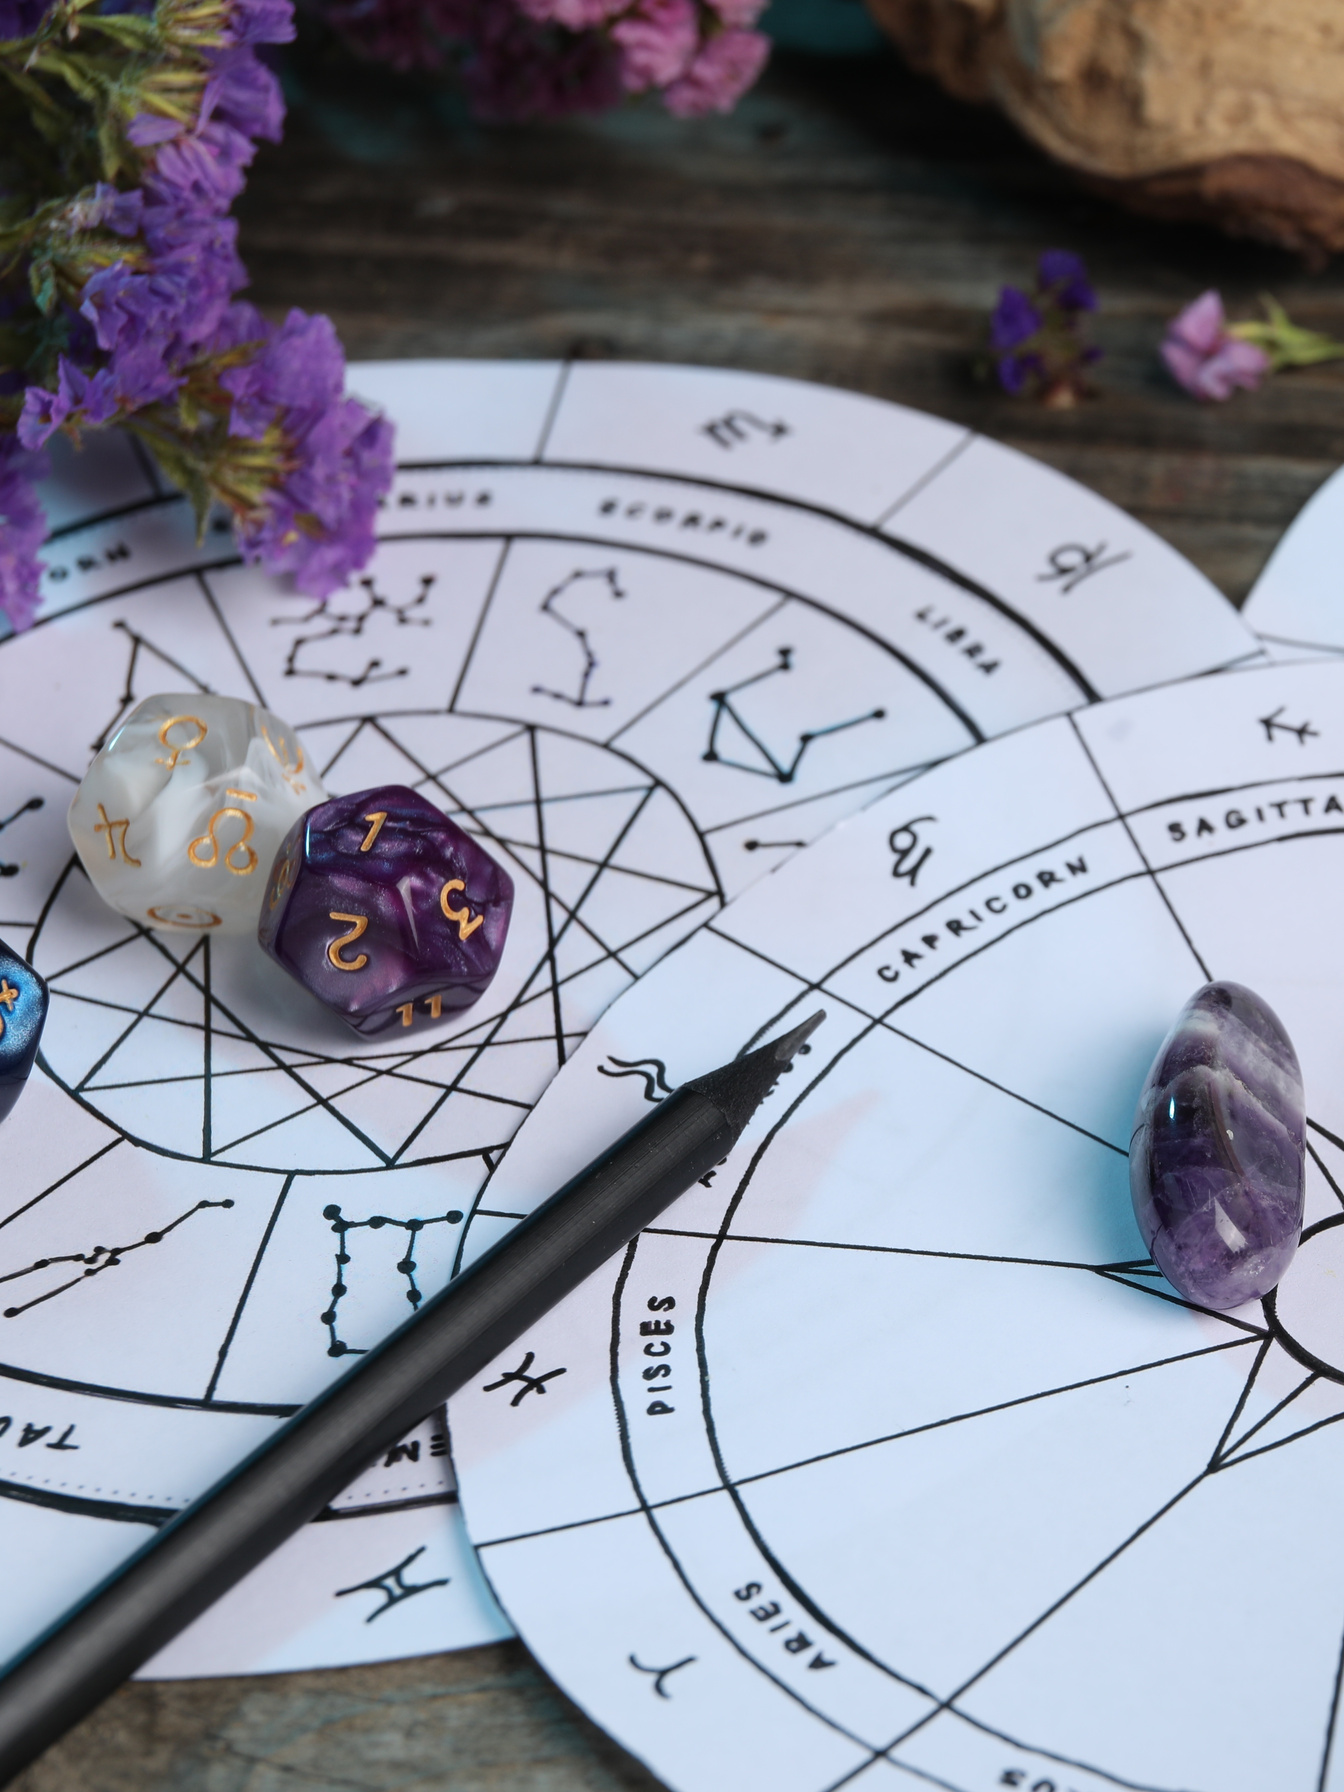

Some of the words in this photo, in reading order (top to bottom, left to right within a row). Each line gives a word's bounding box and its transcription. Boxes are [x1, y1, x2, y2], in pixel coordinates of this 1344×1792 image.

[598, 497, 769, 549] SCORPIO
[913, 604, 1003, 677] LIBRA
[360, 811, 387, 852] 1
[440, 878, 484, 940] 3
[875, 855, 1090, 984] CAPRICORN
[327, 911, 369, 971] 2
[395, 994, 442, 1027] 11
[639, 1295, 677, 1416] PISCES
[733, 1580, 838, 1672] ARIES
